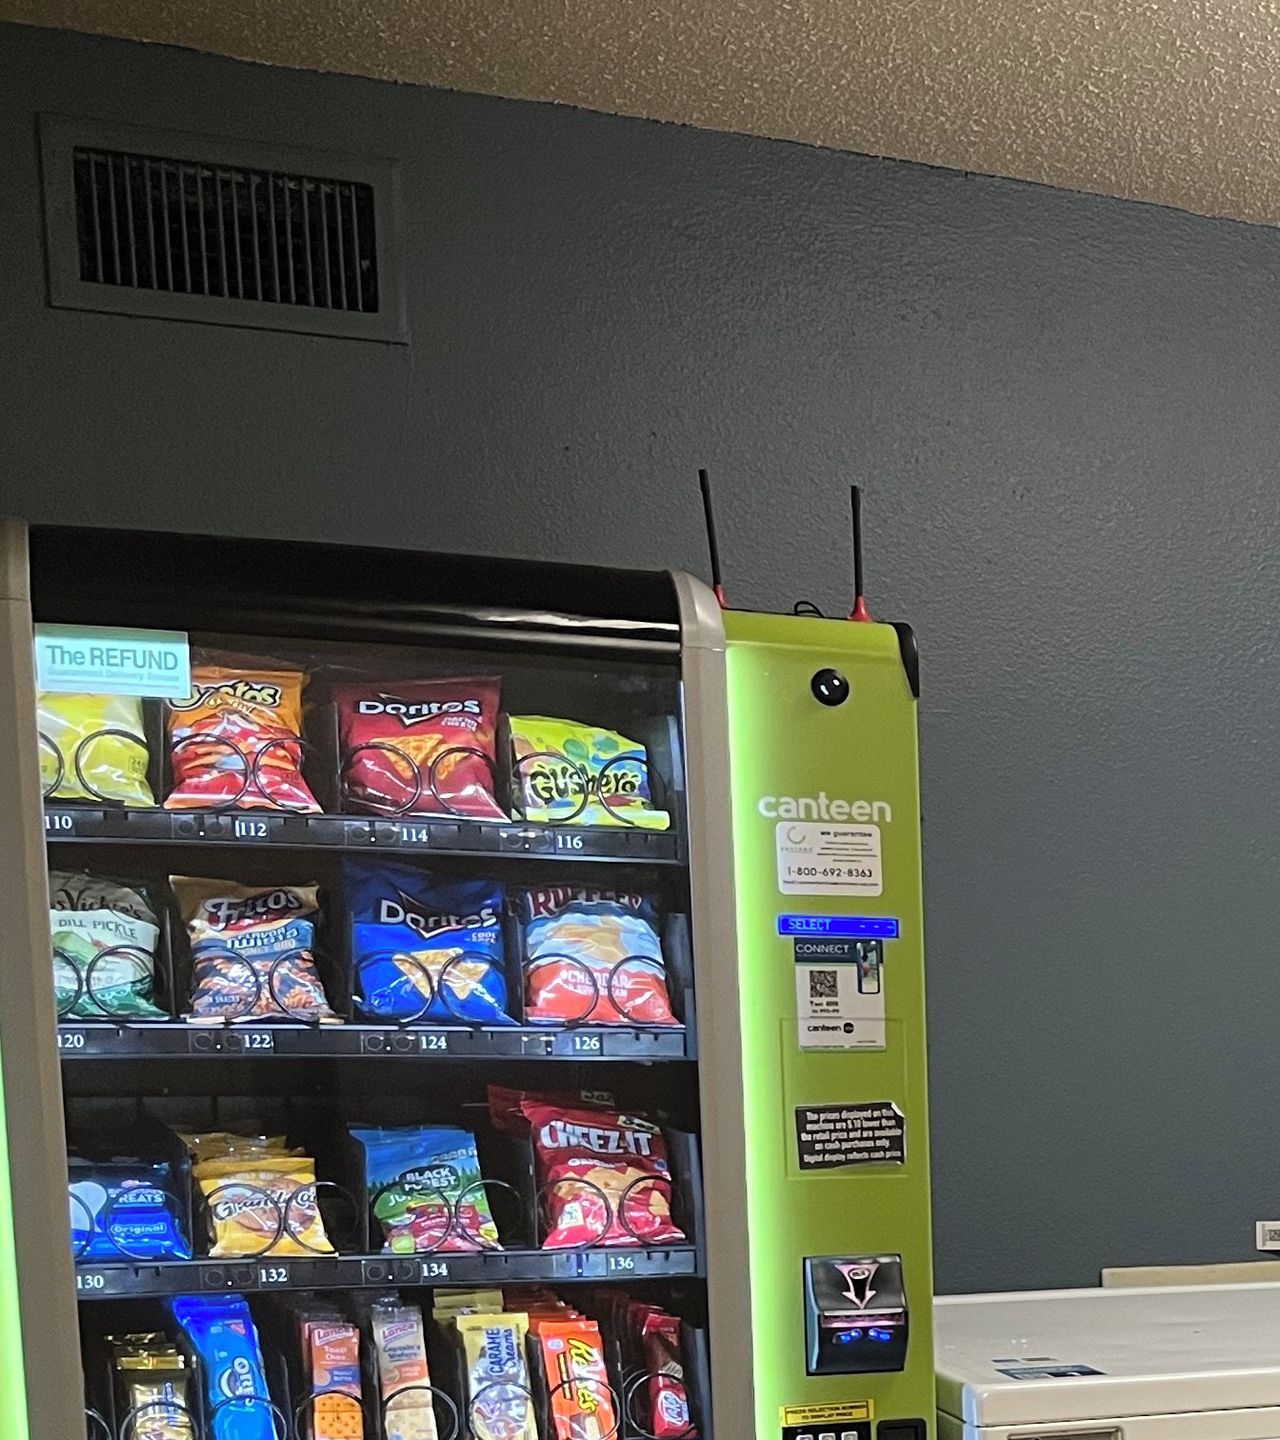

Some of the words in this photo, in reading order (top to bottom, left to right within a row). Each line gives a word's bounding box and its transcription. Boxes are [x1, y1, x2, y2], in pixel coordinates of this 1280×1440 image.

[45, 644, 86, 665] The
[89, 647, 178, 671] REFUND
[359, 698, 480, 717] Doritos
[757, 791, 892, 823] canteen
[44, 813, 73, 831] 110
[401, 827, 428, 843] 114
[556, 833, 583, 851] 116
[787, 866, 873, 878] 1-800-692-8363
[380, 899, 498, 929] Doritos
[58, 918, 88, 928] DILL
[92, 919, 138, 940] PICKLE
[788, 918, 832, 931] SELECT
[795, 943, 850, 954] CONNECT
[807, 1019, 842, 1034] canteen
[57, 1033, 85, 1049] 120
[420, 1036, 447, 1050] 124
[574, 1036, 600, 1050] 126
[540, 1120, 653, 1156] CHEEZ-IT
[406, 1167, 452, 1182] BLACK
[111, 1192, 166, 1204] REATS
[113, 1221, 166, 1235] Original
[421, 1262, 449, 1277] 134
[608, 1256, 635, 1271] 136
[76, 1275, 105, 1291] 130
[260, 1268, 288, 1283] 132
[382, 1321, 416, 1339] Lance
